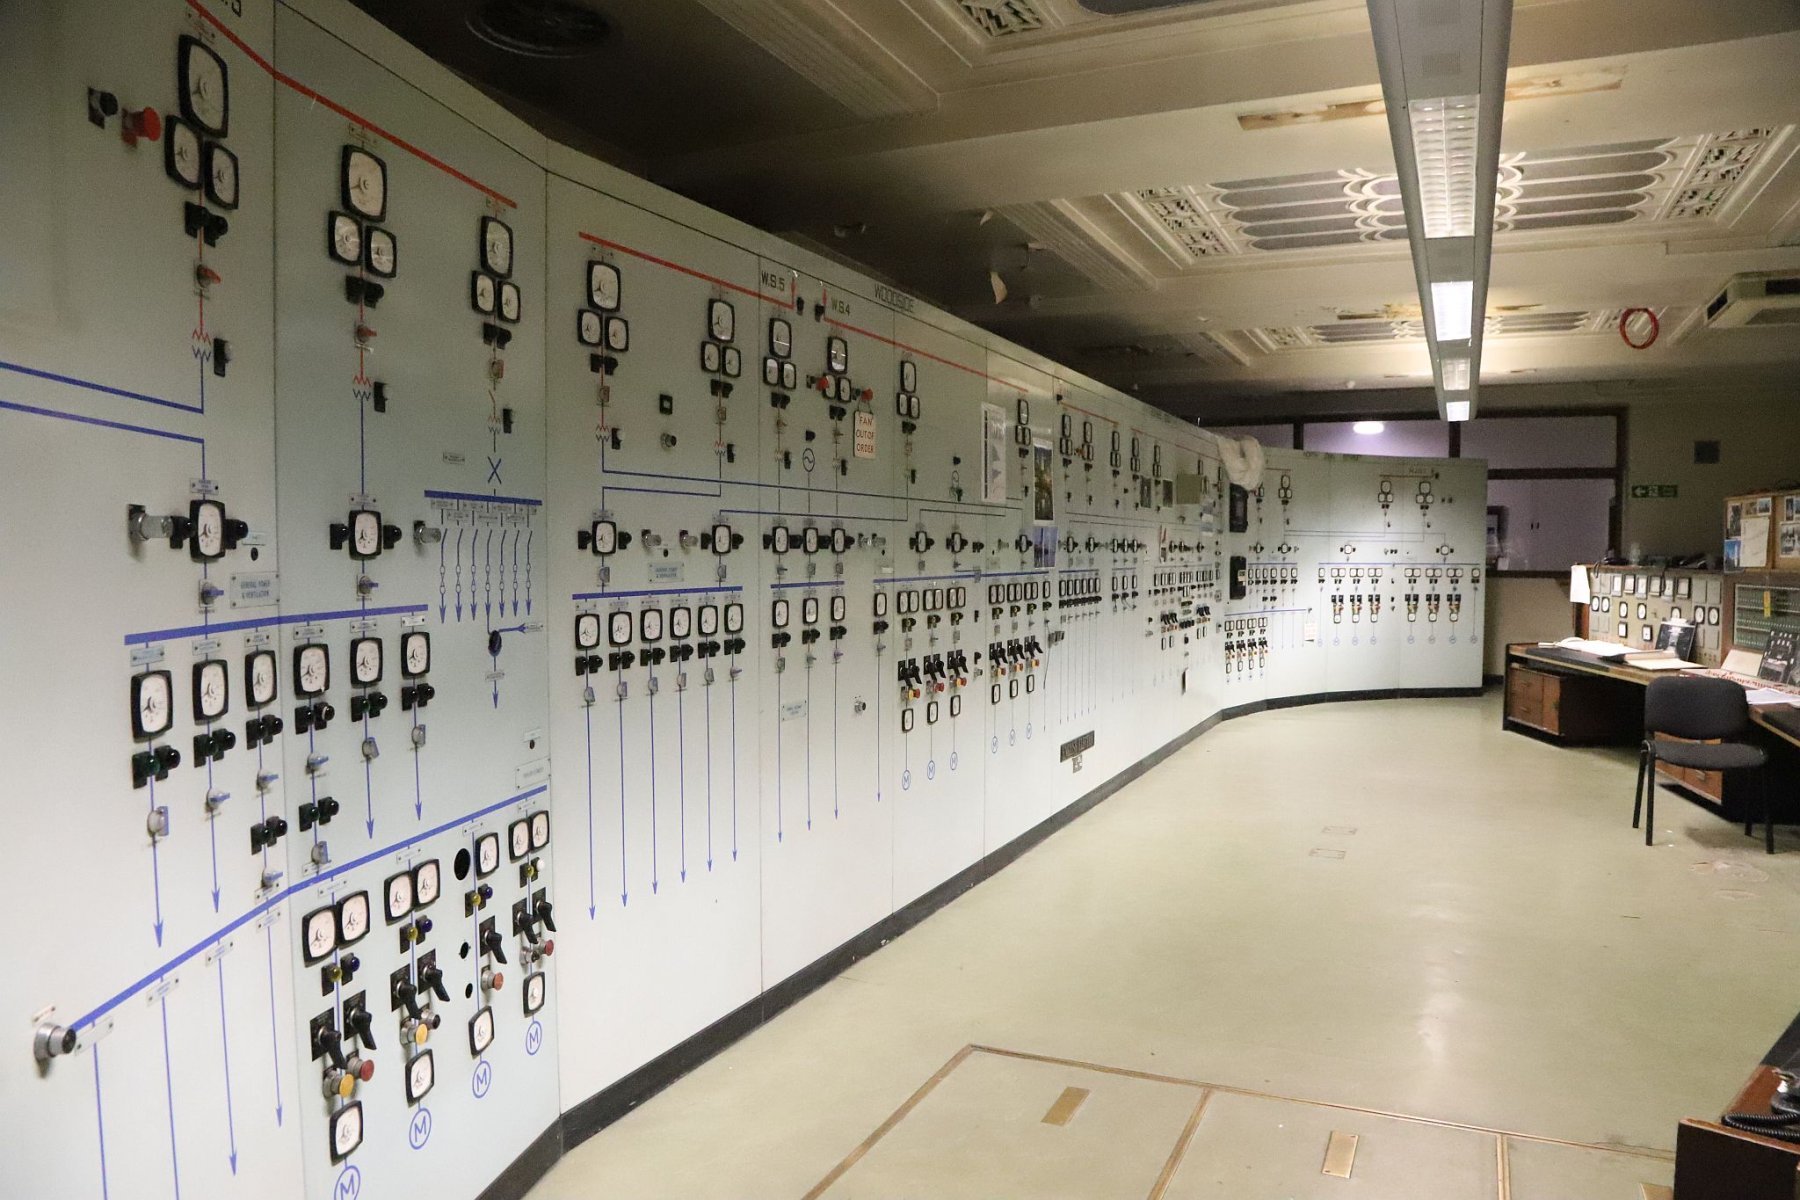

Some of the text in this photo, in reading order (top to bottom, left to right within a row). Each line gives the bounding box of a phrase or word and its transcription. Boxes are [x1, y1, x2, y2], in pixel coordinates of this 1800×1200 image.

[761, 270, 785, 291] W.S.5
[859, 416, 873, 426] FAN
[529, 1027, 539, 1049] M
[476, 1068, 487, 1092] M
[414, 1116, 427, 1142] M
[340, 1174, 355, 1200] M
